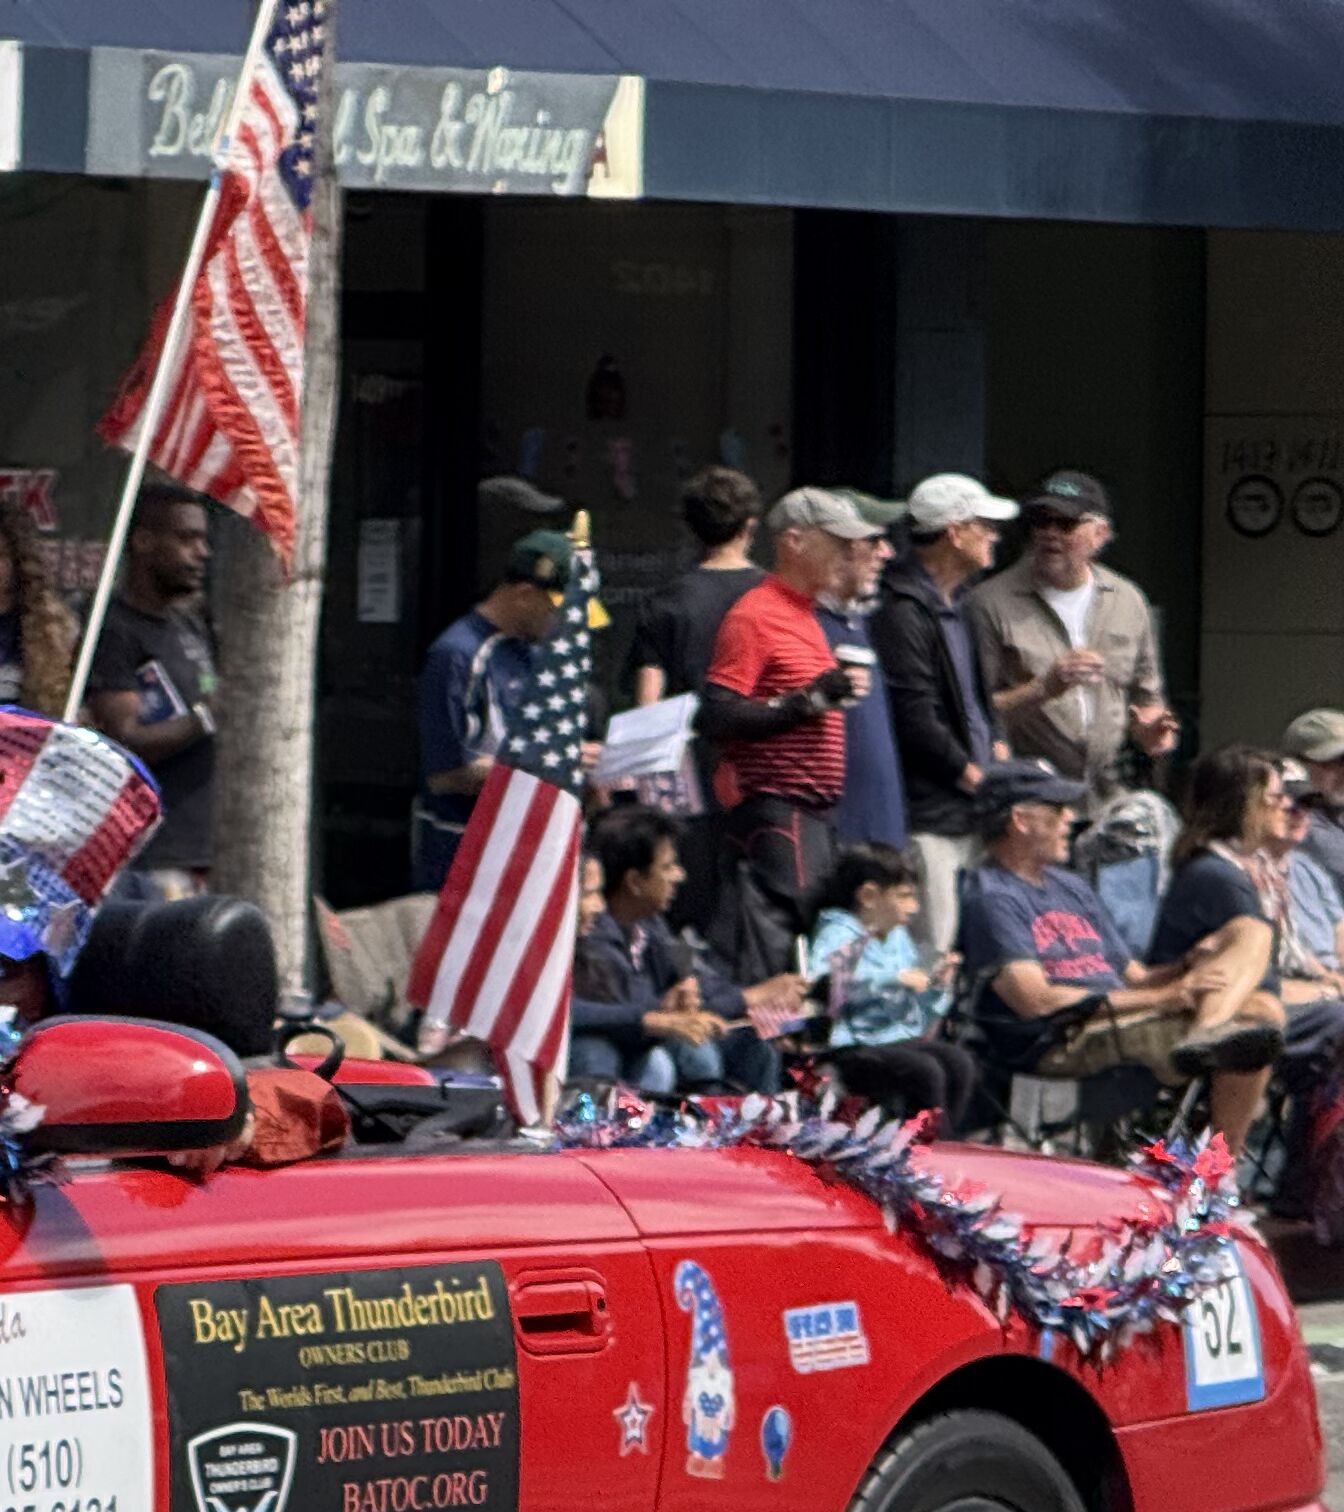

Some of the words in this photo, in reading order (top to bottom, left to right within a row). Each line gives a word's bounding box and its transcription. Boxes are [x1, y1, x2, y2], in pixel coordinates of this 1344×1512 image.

[357, 87, 425, 184] Spa
[430, 82, 463, 169] &
[189, 1298, 248, 1354] Bay
[255, 1295, 324, 1340] Area
[323, 1276, 495, 1333] Thunderbird
[298, 1342, 365, 1368] OWNERS
[366, 1339, 410, 1363] CLUB
[18, 1368, 124, 1417] WHEELS
[6, 1437, 83, 1495] (510)
[316, 1423, 376, 1465] JOIN
[379, 1419, 416, 1458] US
[419, 1411, 506, 1454] TODAY
